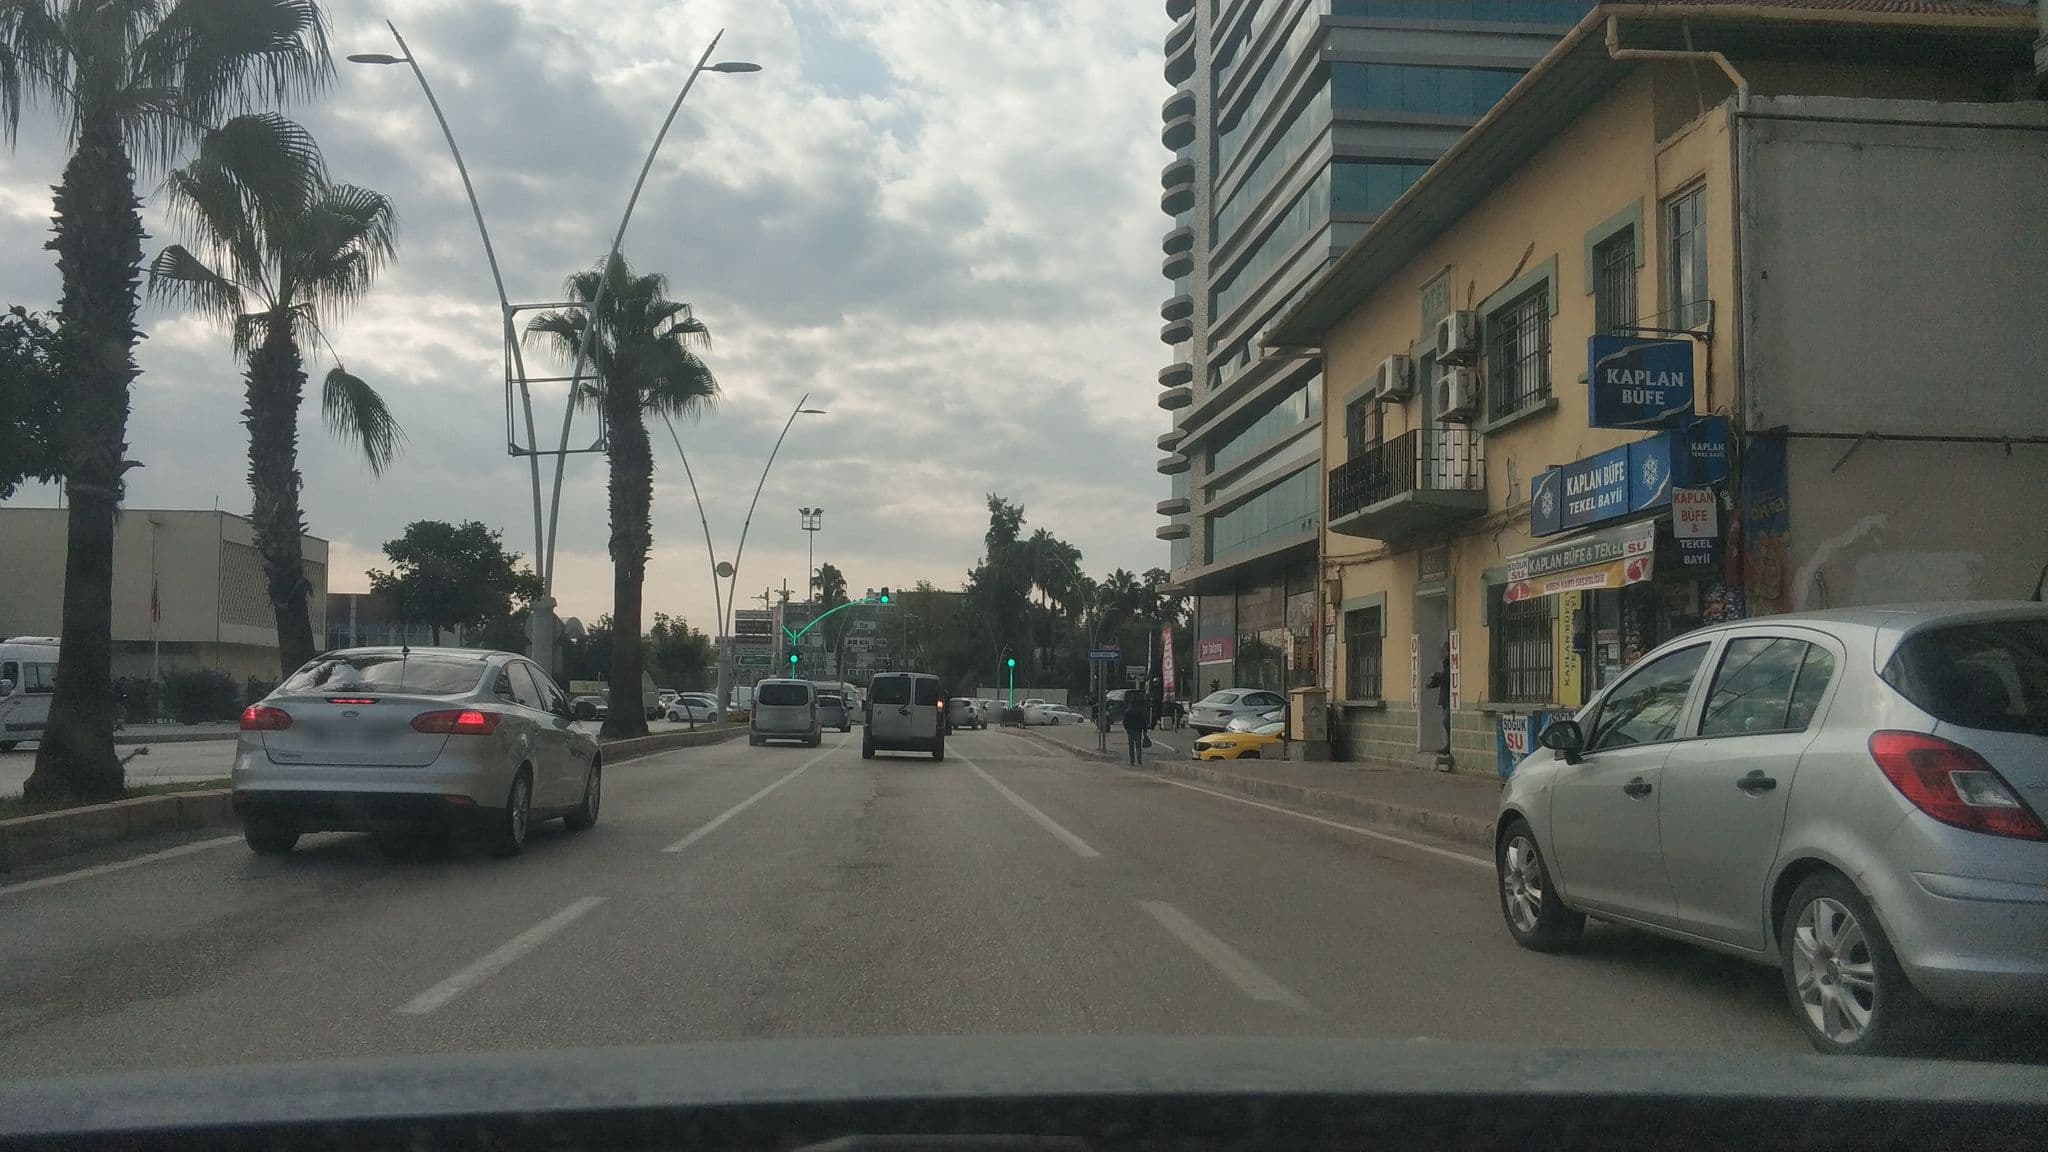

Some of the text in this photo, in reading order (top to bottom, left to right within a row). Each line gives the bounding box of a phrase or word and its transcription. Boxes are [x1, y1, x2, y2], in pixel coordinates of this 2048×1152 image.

[1606, 368, 1684, 387] KAPLAN
[1622, 387, 1665, 405] BÜFE
[1691, 441, 1724, 452] KAPLAN
[1566, 460, 1625, 496] KAPLAN BÜFE
[1569, 496, 1596, 515] TEKEL
[1674, 492, 1714, 504] KAPLAN
[1681, 507, 1708, 522] BÜFE
[1627, 540, 1647, 553] SU
[1679, 539, 1713, 549] TEKEL
[1528, 541, 1623, 574] KAPLAN BÜFE & TEKEL
[1510, 569, 1525, 580] SU
[1451, 634, 1459, 709] UMUT
[1507, 733, 1523, 749] SU
